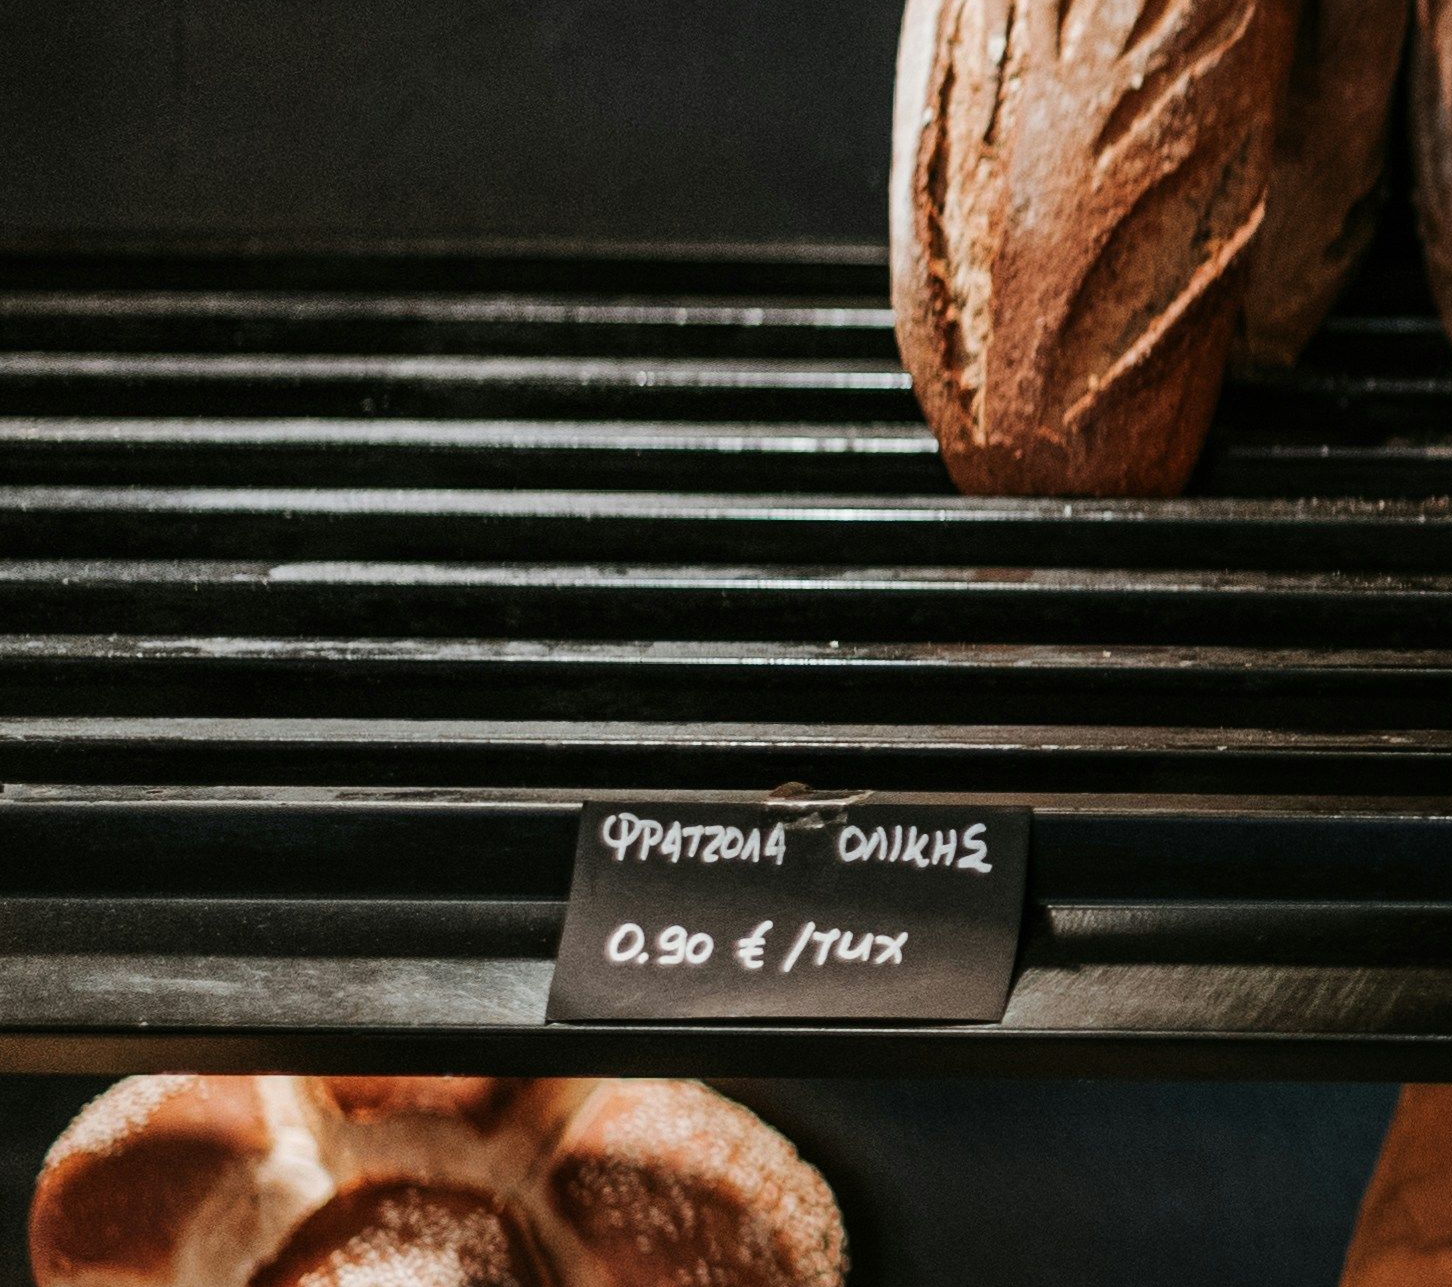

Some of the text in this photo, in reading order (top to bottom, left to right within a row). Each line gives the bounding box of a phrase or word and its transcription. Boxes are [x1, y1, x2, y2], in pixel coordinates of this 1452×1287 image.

[603, 813, 993, 873] ΦΡΑΤΖΟΛΑ ΟΛΙΚΗΣ
[737, 920, 773, 969] €
